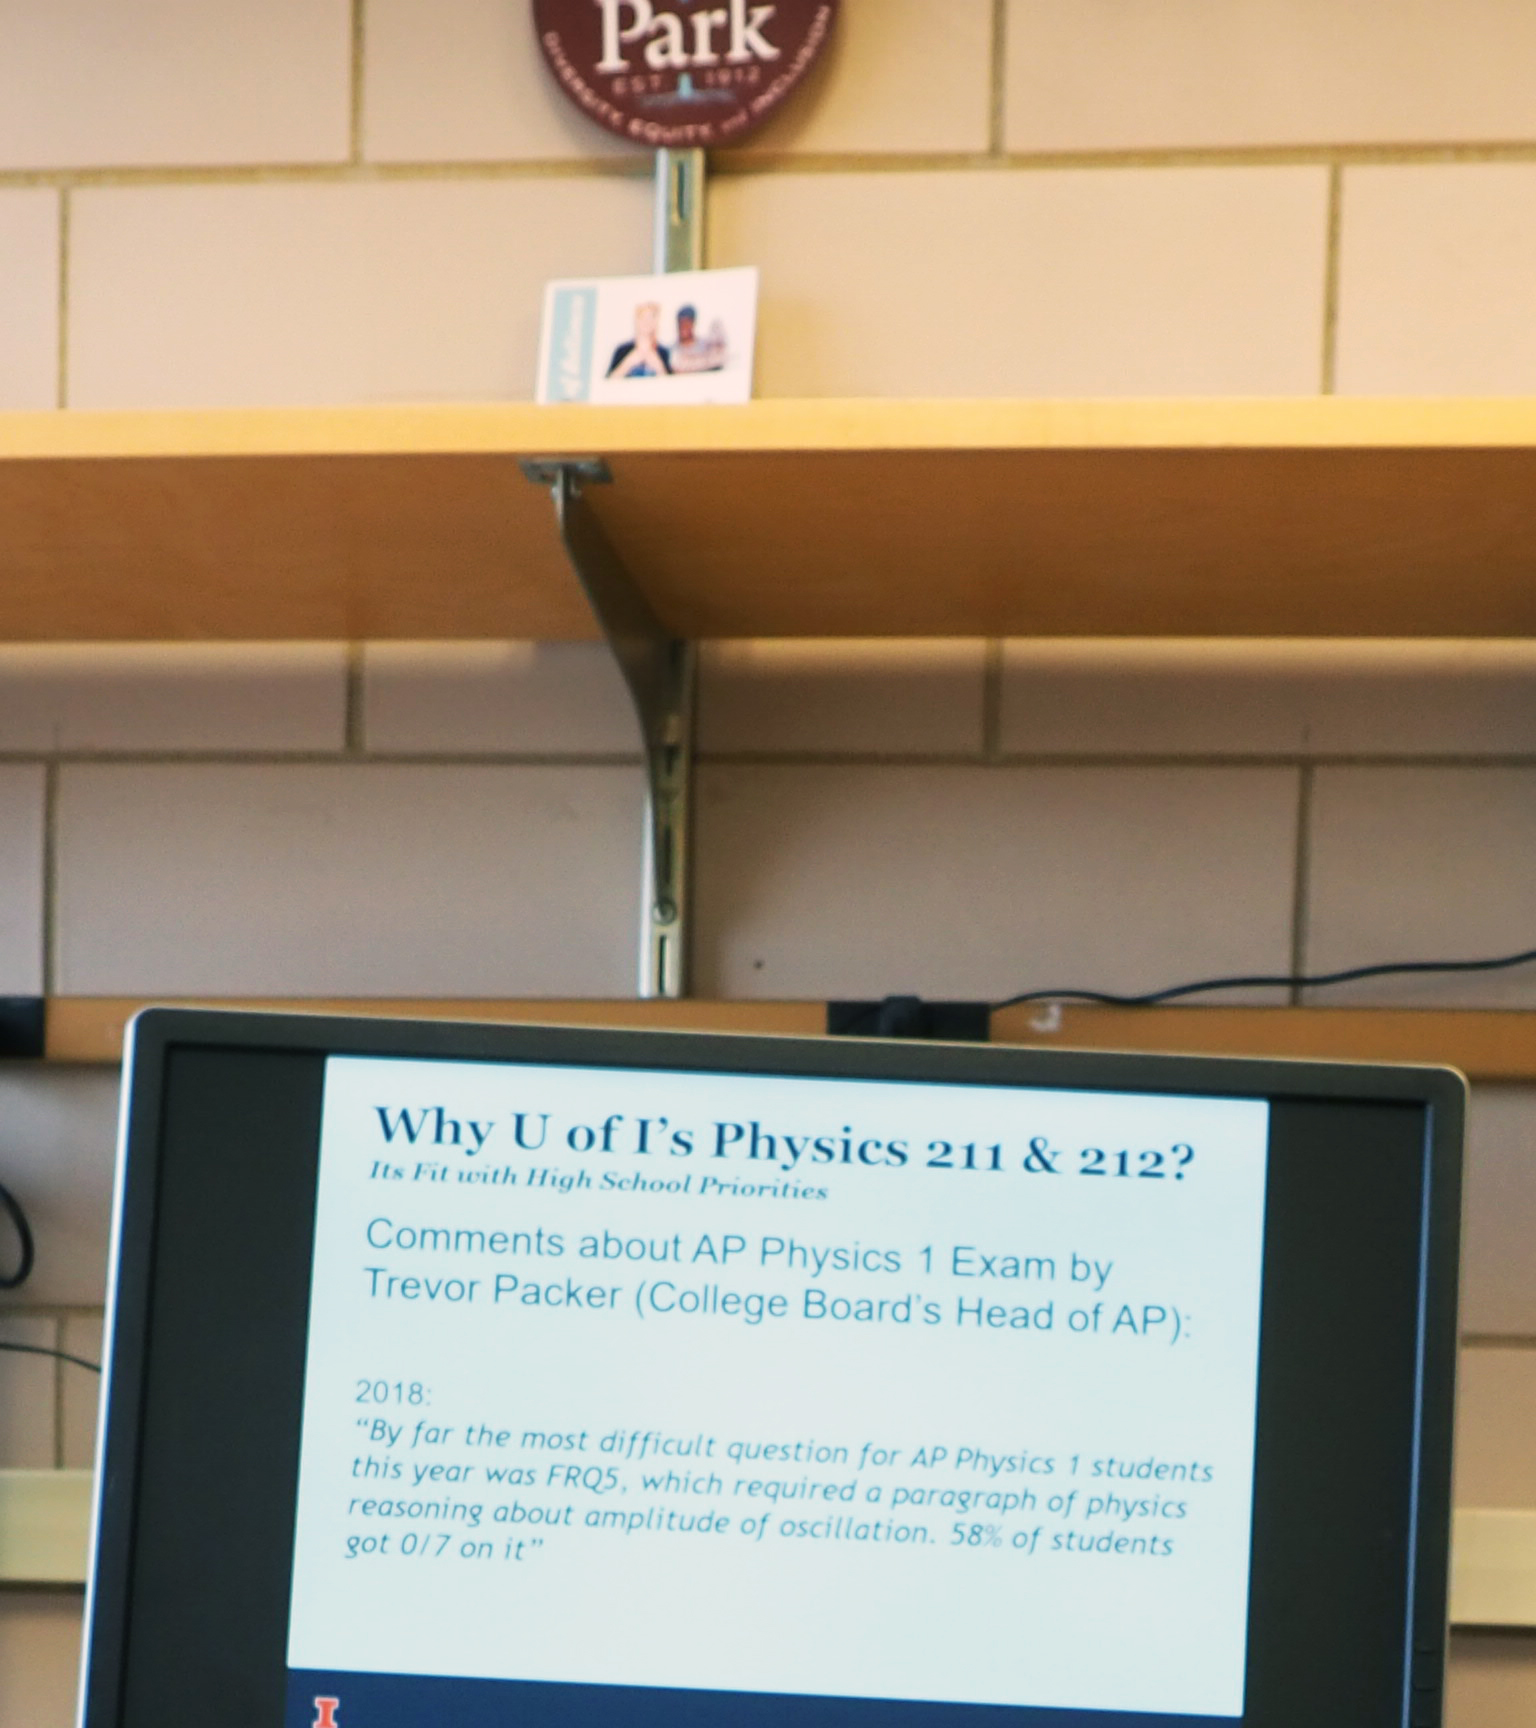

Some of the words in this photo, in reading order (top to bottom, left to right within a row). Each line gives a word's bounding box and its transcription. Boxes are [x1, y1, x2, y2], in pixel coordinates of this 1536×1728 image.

[594, 0, 781, 74] Park
[375, 1105, 495, 1157] Why
[513, 1112, 550, 1150] U
[566, 1114, 625, 1153] of
[713, 1120, 909, 1172] Physics
[926, 1140, 1002, 1172] 211
[1022, 1136, 1060, 1174] &
[1078, 1143, 1195, 1181] 212?
[369, 1160, 404, 1180] Its
[413, 1162, 449, 1182] Fit
[457, 1165, 518, 1185] with
[526, 1167, 592, 1193] High
[599, 1171, 692, 1194] School
[698, 1175, 828, 1201] Priorities
[366, 1216, 566, 1257] Comments
[578, 1228, 682, 1263] about
[691, 1233, 747, 1265] AP
[760, 1235, 902, 1279] Physics
[920, 1244, 933, 1274] 1
[951, 1245, 1056, 1281] Exam
[1070, 1251, 1114, 1292] by
[363, 1266, 481, 1303] Trevor
[493, 1273, 623, 1309] Packer
[635, 1280, 789, 1326] (College
[956, 1295, 1055, 1331] Head
[1067, 1301, 1105, 1333] of
[1111, 1303, 1190, 1345] AP):
[354, 1378, 431, 1406] 2018:
[410, 1419, 455, 1449] far
[465, 1423, 512, 1448] the
[520, 1430, 589, 1452] most
[598, 1429, 716, 1460] difficult
[726, 1439, 849, 1465] question
[857, 1441, 903, 1471] for
[910, 1445, 949, 1468] AP
[954, 1446, 1056, 1479] Physics
[1071, 1453, 1080, 1476] 1
[1091, 1456, 1214, 1483] students
[351, 1455, 403, 1480] this
[411, 1463, 475, 1487] year
[485, 1467, 537, 1487] was
[546, 1463, 628, 1495] FRQ5,
[641, 1469, 723, 1495] which
[733, 1476, 858, 1505] required
[865, 1485, 883, 1504] a
[890, 1487, 1038, 1516] paragraph
[1046, 1489, 1079, 1519] of
[1084, 1491, 1187, 1523] physics
[344, 1533, 391, 1559] got
[399, 1531, 453, 1557] 0/7
[459, 1540, 494, 1559] on
[348, 1496, 484, 1529] reasoning
[492, 1499, 574, 1527] about
[583, 1506, 731, 1536] amplitude
[739, 1512, 772, 1542] of
[779, 1515, 936, 1545] oscillation.
[950, 1521, 1002, 1547] 58%
[1011, 1525, 1044, 1555] of
[1050, 1530, 1174, 1557] students
